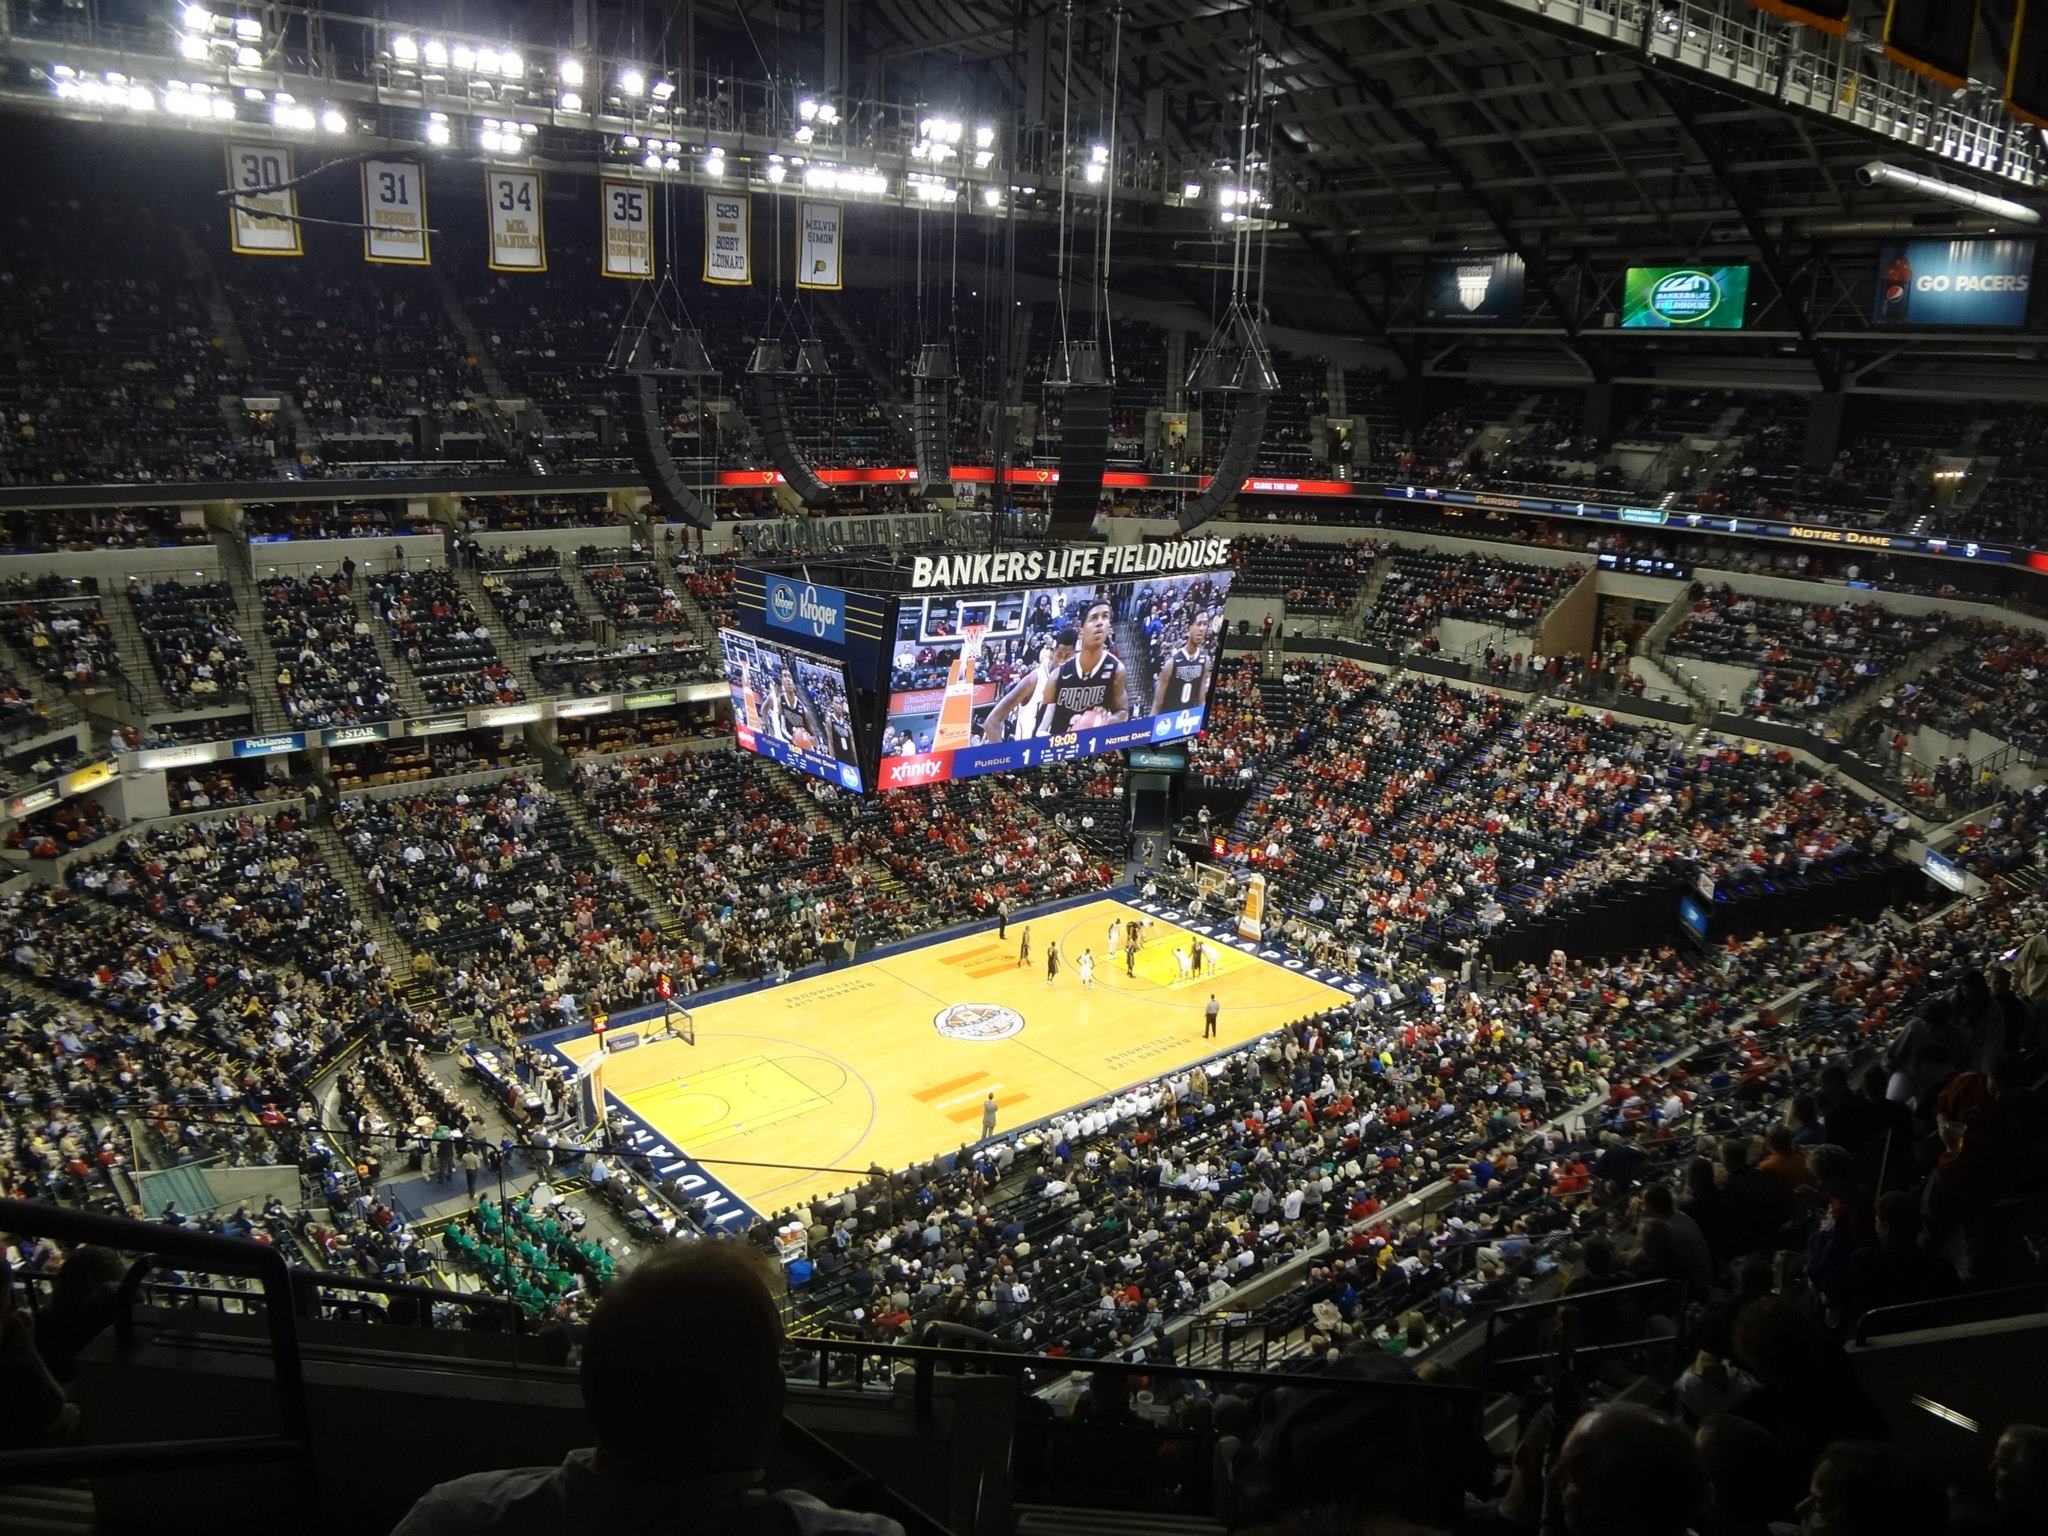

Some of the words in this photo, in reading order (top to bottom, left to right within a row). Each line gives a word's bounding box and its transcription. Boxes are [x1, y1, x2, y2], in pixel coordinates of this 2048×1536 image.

[240, 154, 281, 188] 30
[379, 171, 409, 205] 31
[498, 180, 531, 212] 34
[613, 191, 643, 222] 35
[716, 203, 739, 219] 529
[805, 219, 837, 232] MELVIN
[715, 234, 740, 252] BOBBY
[807, 231, 834, 244] SIMON
[711, 252, 745, 270] LEONARD
[1916, 275, 1950, 292] GO
[1954, 275, 2029, 292] PACERS
[1475, 494, 1521, 508] PURDUE
[1576, 503, 1585, 516] 1
[1728, 518, 1738, 532] 1
[1789, 526, 1842, 541] NOTRE
[1846, 532, 1891, 546] DAME
[912, 551, 1043, 588] BANKERS
[1046, 548, 1097, 580] LIFE
[1099, 538, 1232, 575] FIELDHOUSE
[800, 585, 837, 637] Kroger
[624, 692, 676, 704] bankerslife.com
[1057, 685, 1107, 712] PURDUE
[1180, 682, 1192, 703] 0
[343, 726, 374, 739] STAR
[1049, 732, 1078, 748] 19:09
[1105, 734, 1130, 746] NOTRE
[1131, 730, 1151, 741] DAME
[245, 736, 293, 749] ProLiance
[1088, 738, 1097, 753] 1
[974, 756, 1012, 768] PURDUE
[1022, 749, 1031, 765] 1
[891, 759, 942, 781] xfinity
[1126, 898, 1367, 993] INDIANAPOLIS
